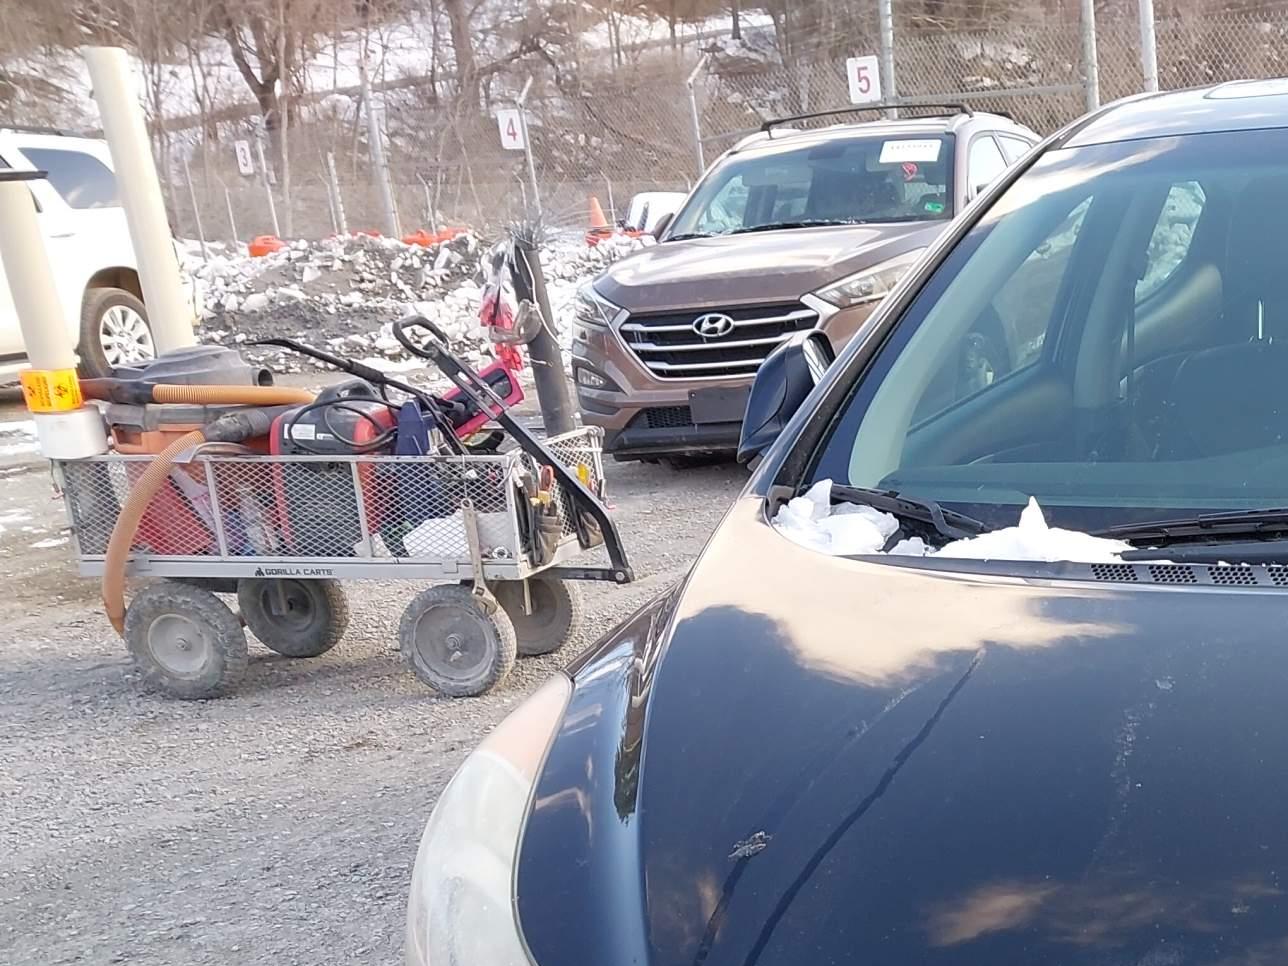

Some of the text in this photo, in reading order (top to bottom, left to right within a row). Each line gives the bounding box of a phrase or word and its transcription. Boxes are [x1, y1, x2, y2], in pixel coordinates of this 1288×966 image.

[857, 66, 870, 94] 5
[507, 117, 517, 142] 4
[240, 146, 248, 167] 3
[264, 568, 333, 576] GORILLA CARTS
